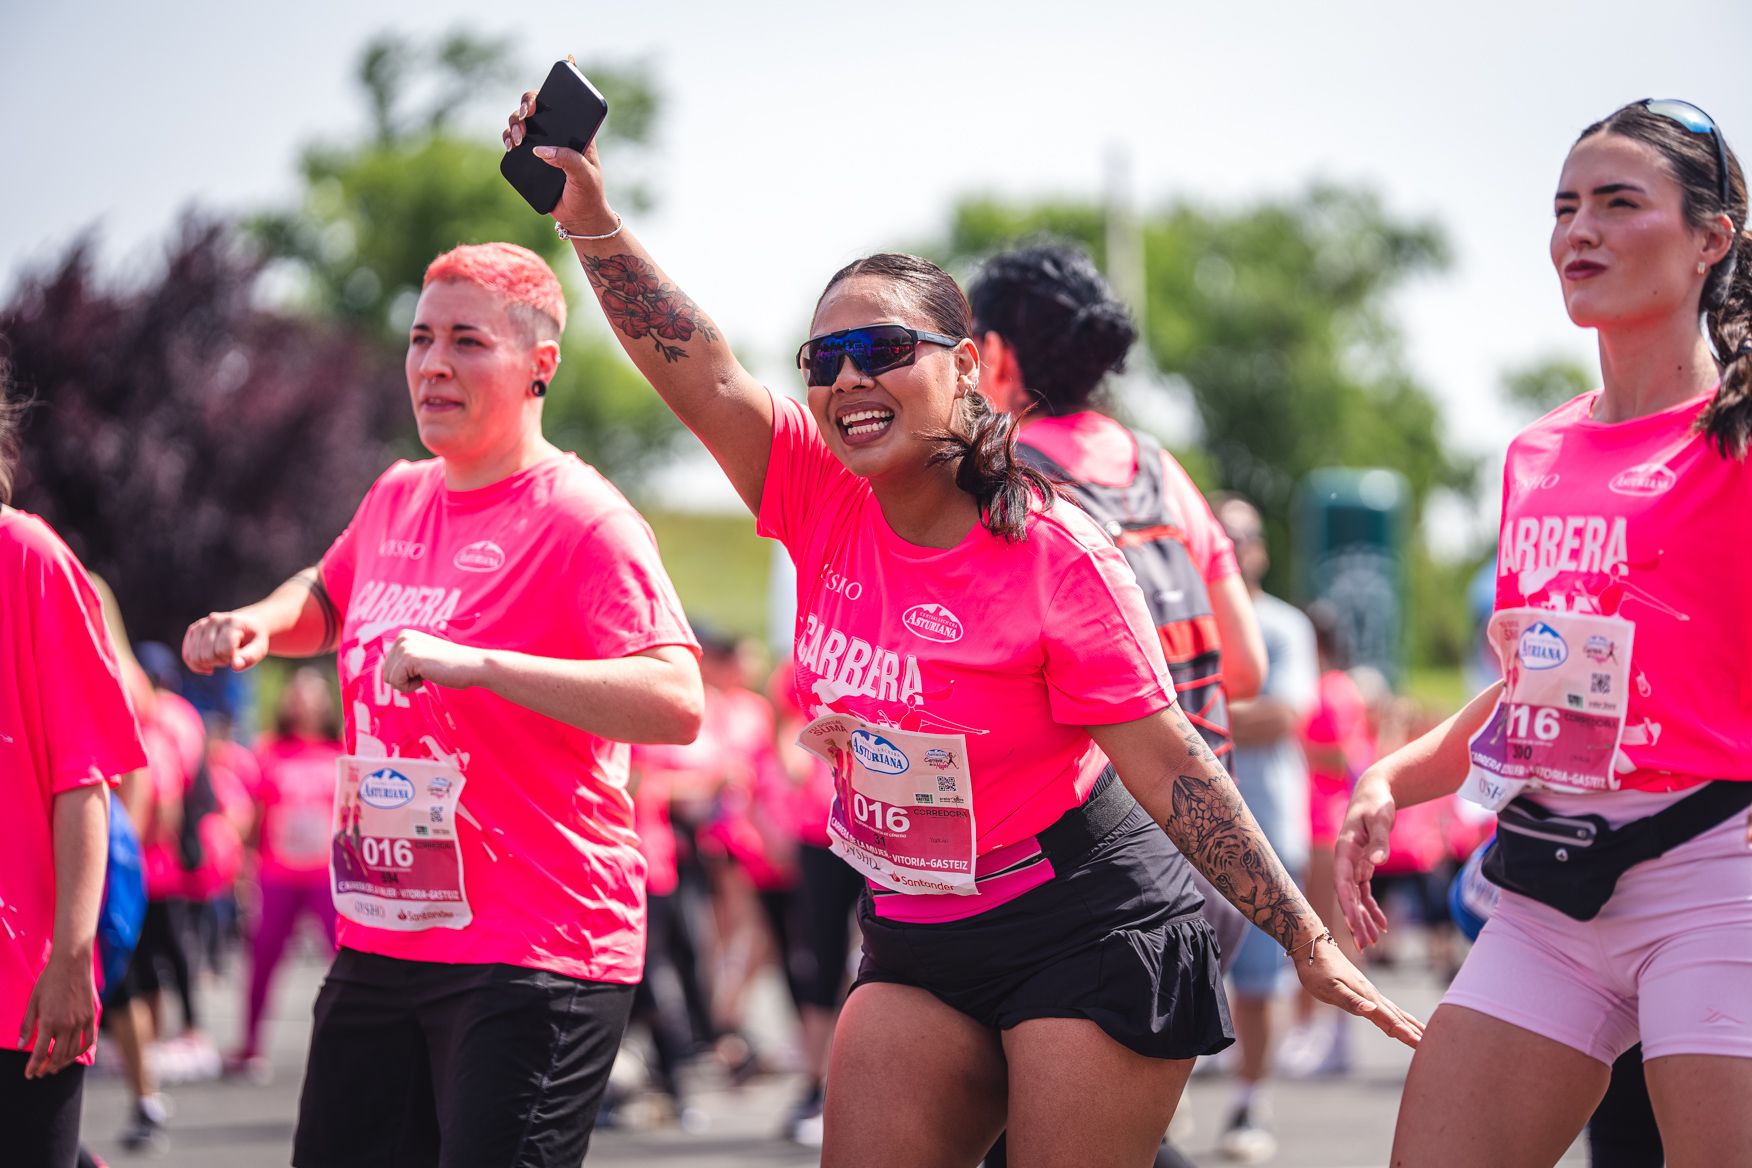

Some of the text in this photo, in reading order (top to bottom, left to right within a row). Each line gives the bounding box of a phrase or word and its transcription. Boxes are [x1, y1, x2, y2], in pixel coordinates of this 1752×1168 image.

[1500, 516, 1629, 576] ARRERA
[906, 610, 957, 640] ASTURIANA
[797, 612, 924, 706] CARRERA
[813, 724, 847, 737] SUMA
[853, 736, 904, 770] ASTURIANA
[854, 793, 910, 833] 016
[913, 808, 968, 819] CORREDORA
[362, 837, 414, 868] 016
[873, 833, 887, 849] 31
[901, 875, 955, 891] Santander
